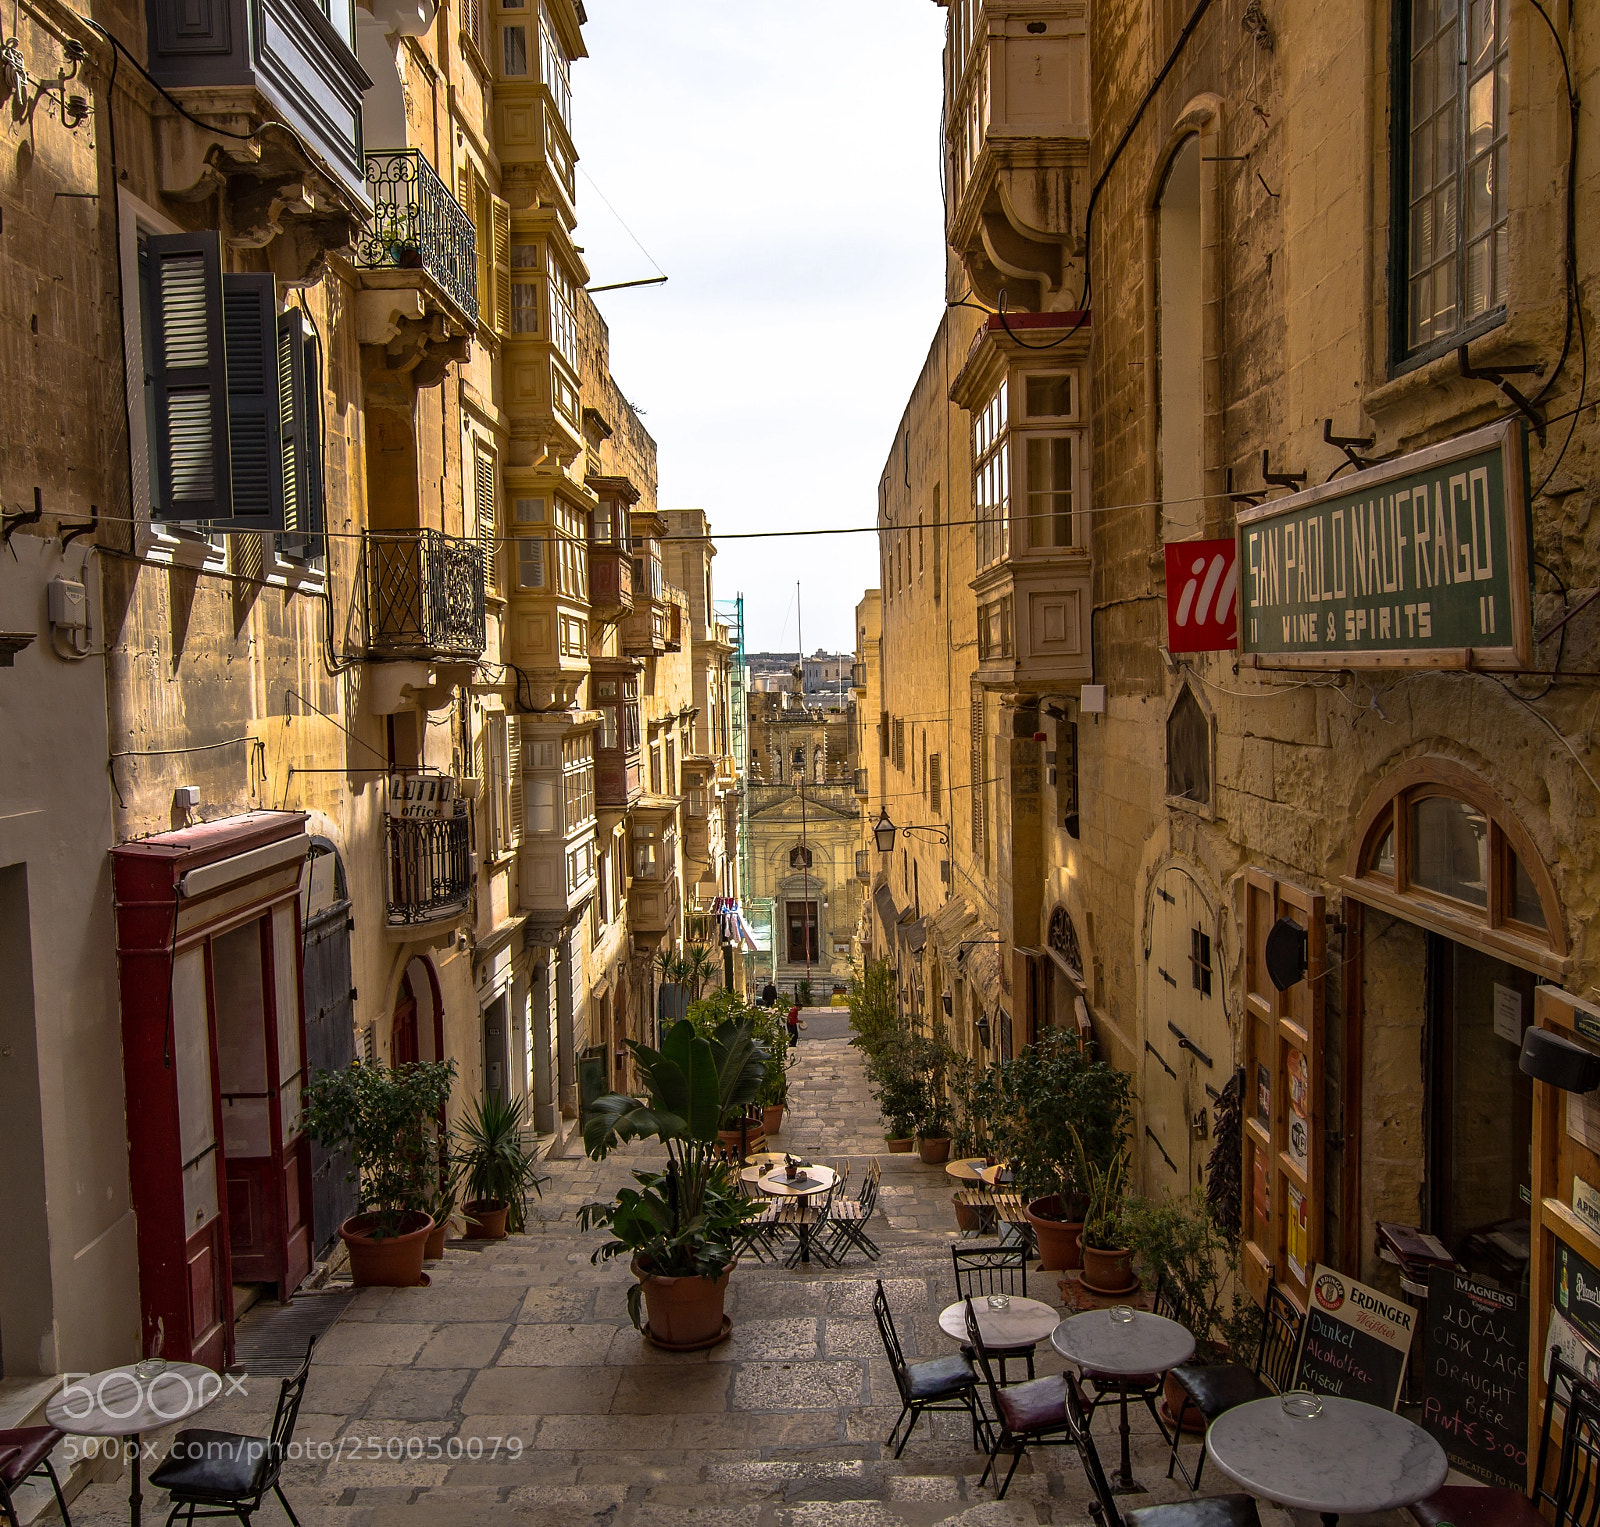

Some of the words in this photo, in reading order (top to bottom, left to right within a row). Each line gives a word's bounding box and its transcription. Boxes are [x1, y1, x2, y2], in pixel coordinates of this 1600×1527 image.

[1249, 527, 1280, 607] SAN
[1285, 509, 1347, 604] PAOLO
[1351, 466, 1493, 597] NAUFRAGO
[1175, 553, 1237, 640] ill
[1282, 612, 1318, 643] WINE
[1326, 611, 1337, 642] &
[1345, 602, 1432, 641] SPIRITS
[1350, 1287, 1411, 1332] ERDINGER
[1456, 1277, 1514, 1307] MAGNERS
[1311, 1314, 1355, 1349] Dunkel
[1433, 1326, 1473, 1358] CISK
[1442, 1305, 1516, 1347] LOCAL
[1302, 1360, 1343, 1395] Kristall
[1436, 1357, 1516, 1405] DRAUGHT
[1465, 1395, 1509, 1430] BEER
[1447, 1452, 1492, 1479] DEDICATED
[1494, 1473, 1506, 1486] TO
